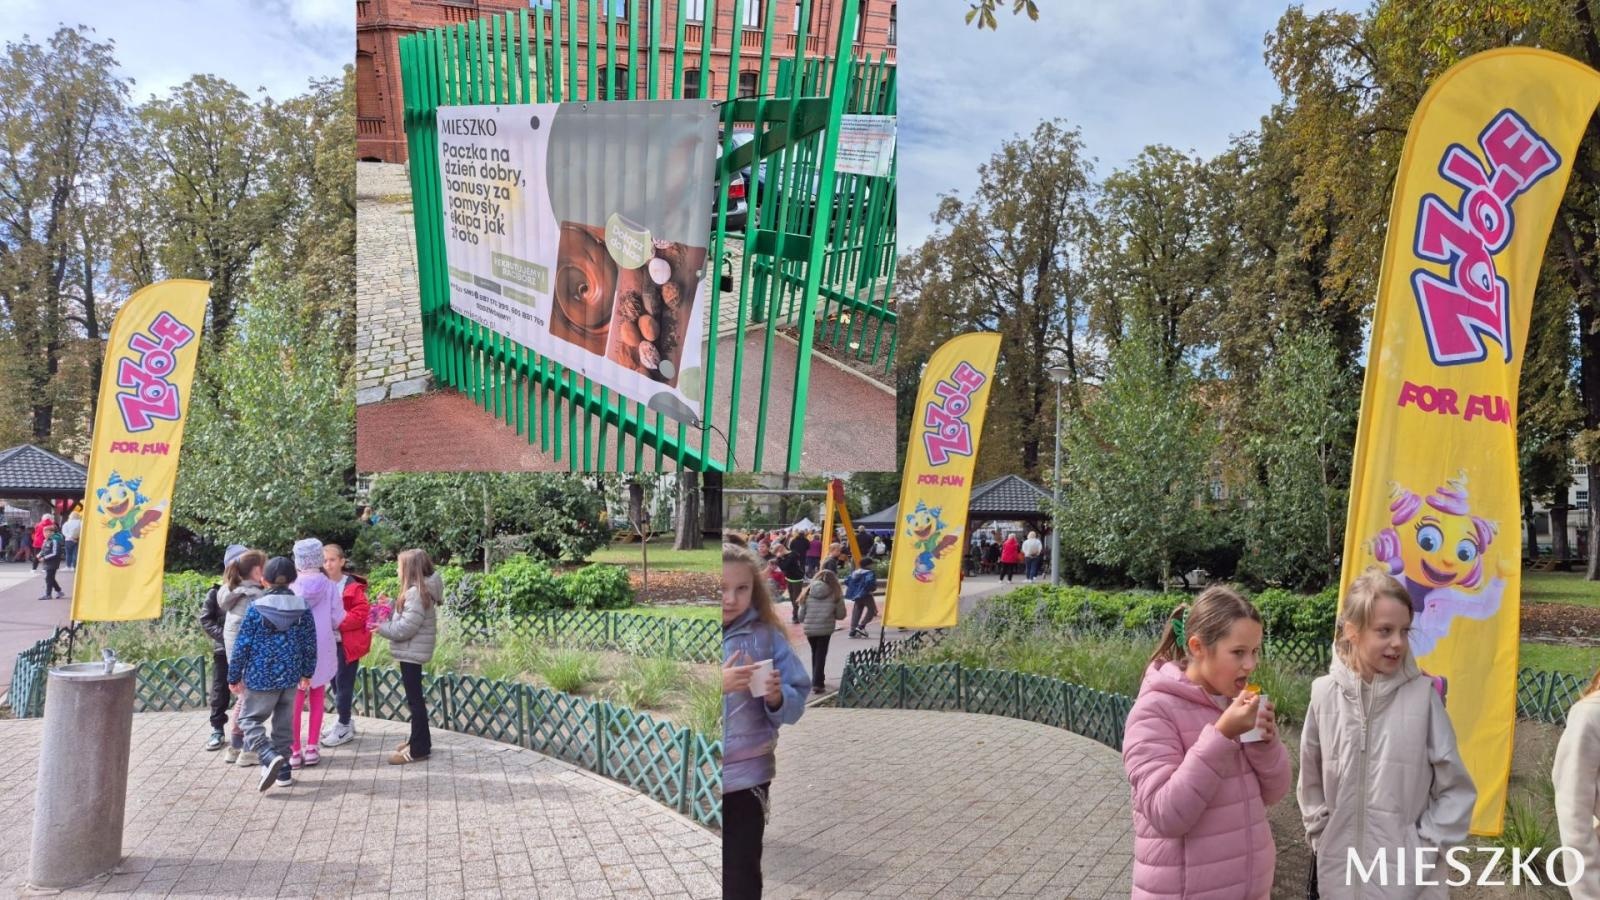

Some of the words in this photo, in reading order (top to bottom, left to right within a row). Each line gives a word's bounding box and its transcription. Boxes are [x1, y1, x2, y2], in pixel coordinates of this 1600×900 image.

[441, 118, 497, 136] MIESZKO
[442, 142, 487, 160] Paczka
[491, 148, 510, 162] na
[445, 159, 477, 178] dzień
[480, 163, 526, 187] dobry,
[445, 175, 490, 200] bonusy
[494, 186, 510, 200] za
[449, 195, 504, 219] pomysły,
[450, 211, 480, 230] ekipa
[484, 215, 505, 235] jak
[452, 226, 479, 245] złoto
[116, 311, 195, 432] ZOZOLE
[1398, 381, 1460, 415] FOR
[924, 361, 986, 466] ZOZOLE
[110, 441, 139, 454] FOR
[141, 442, 170, 455] FUN
[917, 474, 939, 485] FOR
[940, 475, 964, 487] FUN
